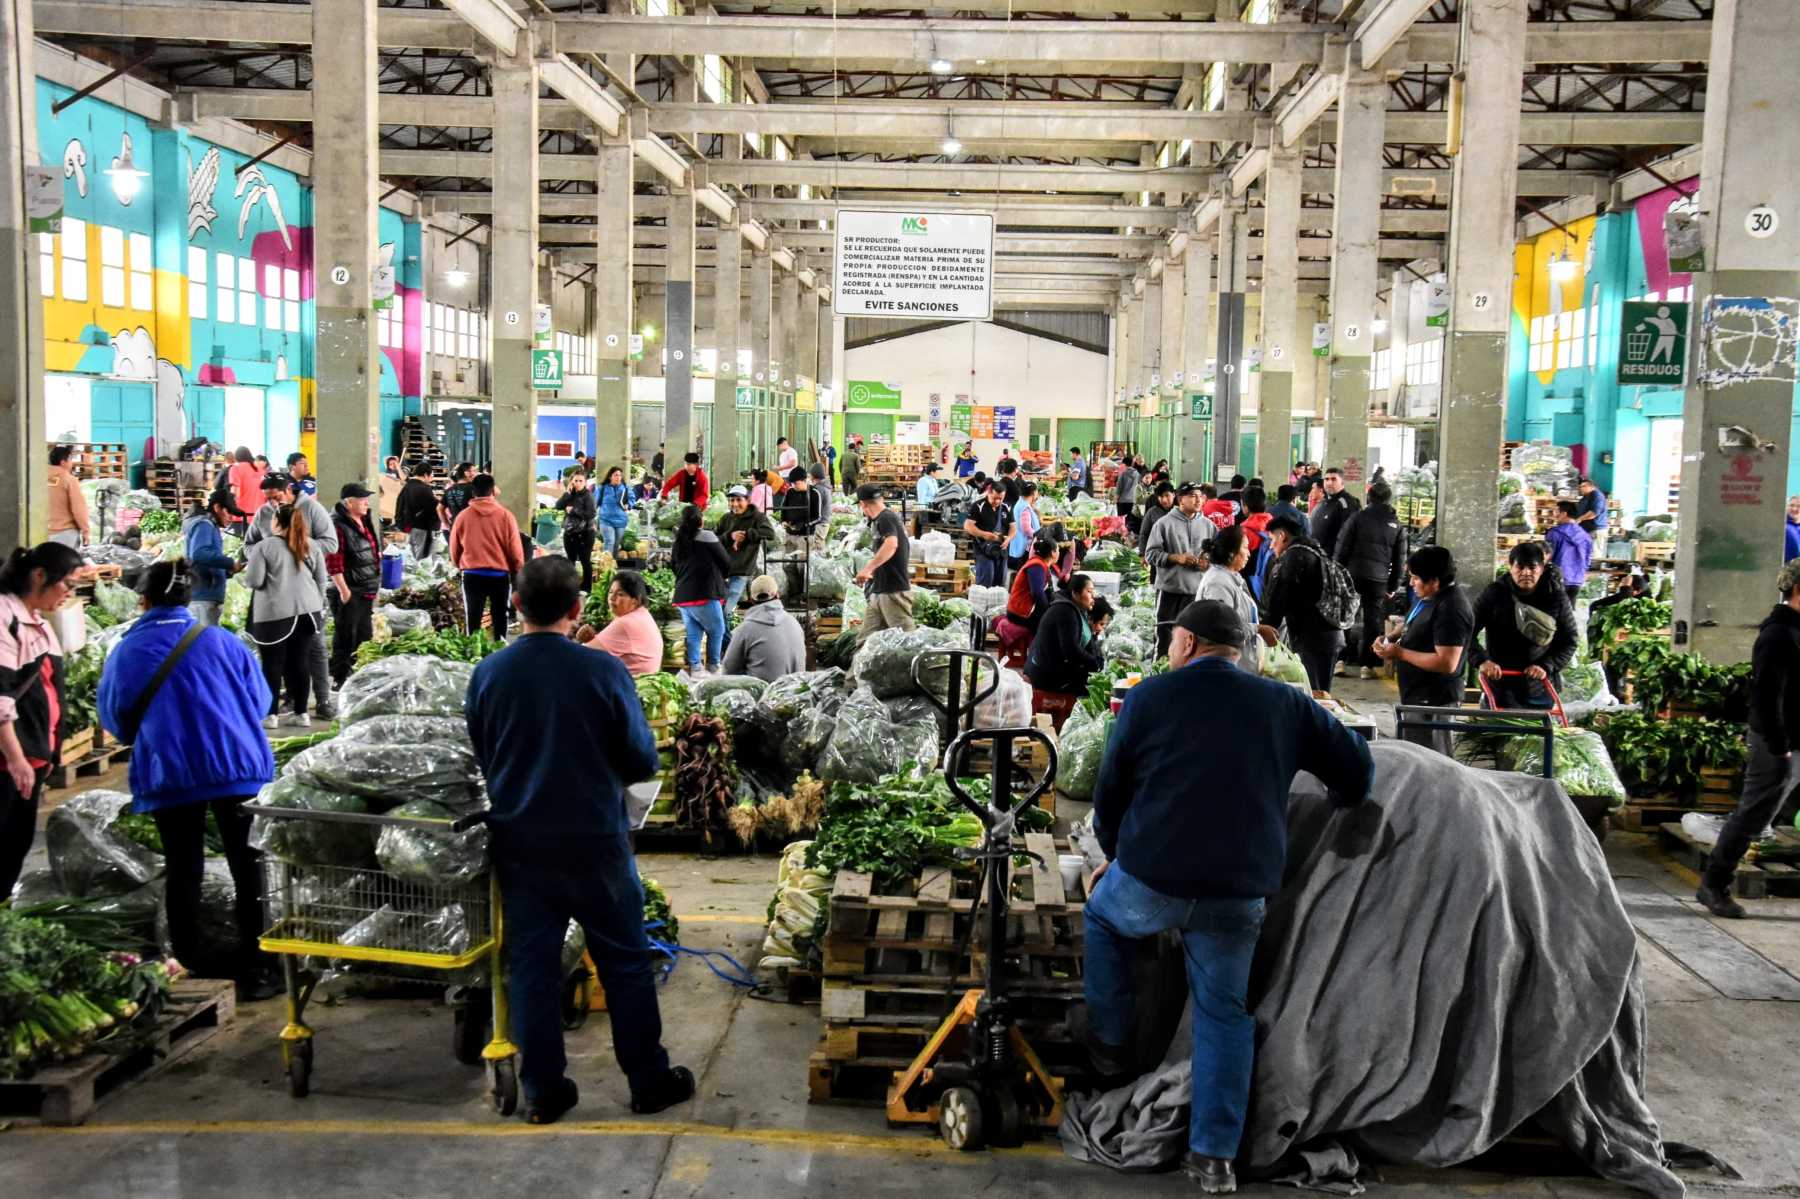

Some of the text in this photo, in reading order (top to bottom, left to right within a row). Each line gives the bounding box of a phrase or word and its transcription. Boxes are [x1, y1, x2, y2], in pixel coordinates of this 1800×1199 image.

[1751, 214, 1772, 232] 30
[336, 270, 345, 282] 12
[866, 300, 958, 312] EVITE SANCIONES
[1476, 296, 1487, 308] 29
[1348, 328, 1356, 336] 28
[1622, 363, 1681, 376] RESIDUOS
